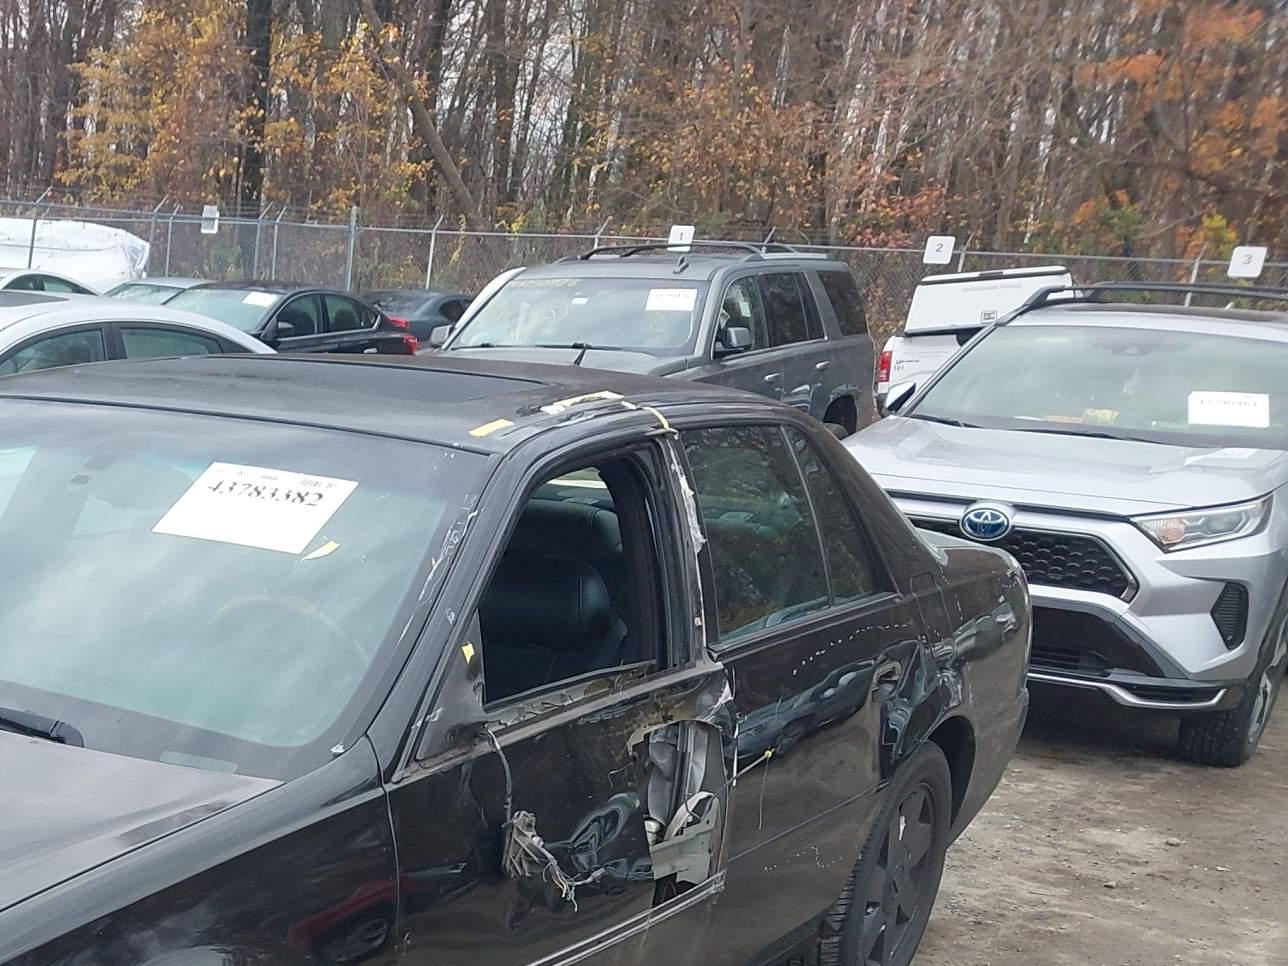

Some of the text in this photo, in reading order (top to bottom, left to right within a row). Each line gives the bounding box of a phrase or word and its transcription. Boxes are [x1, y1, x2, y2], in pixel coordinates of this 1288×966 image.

[935, 242, 944, 253] 2
[1242, 254, 1253, 265] 3
[208, 480, 324, 506] 43783382
